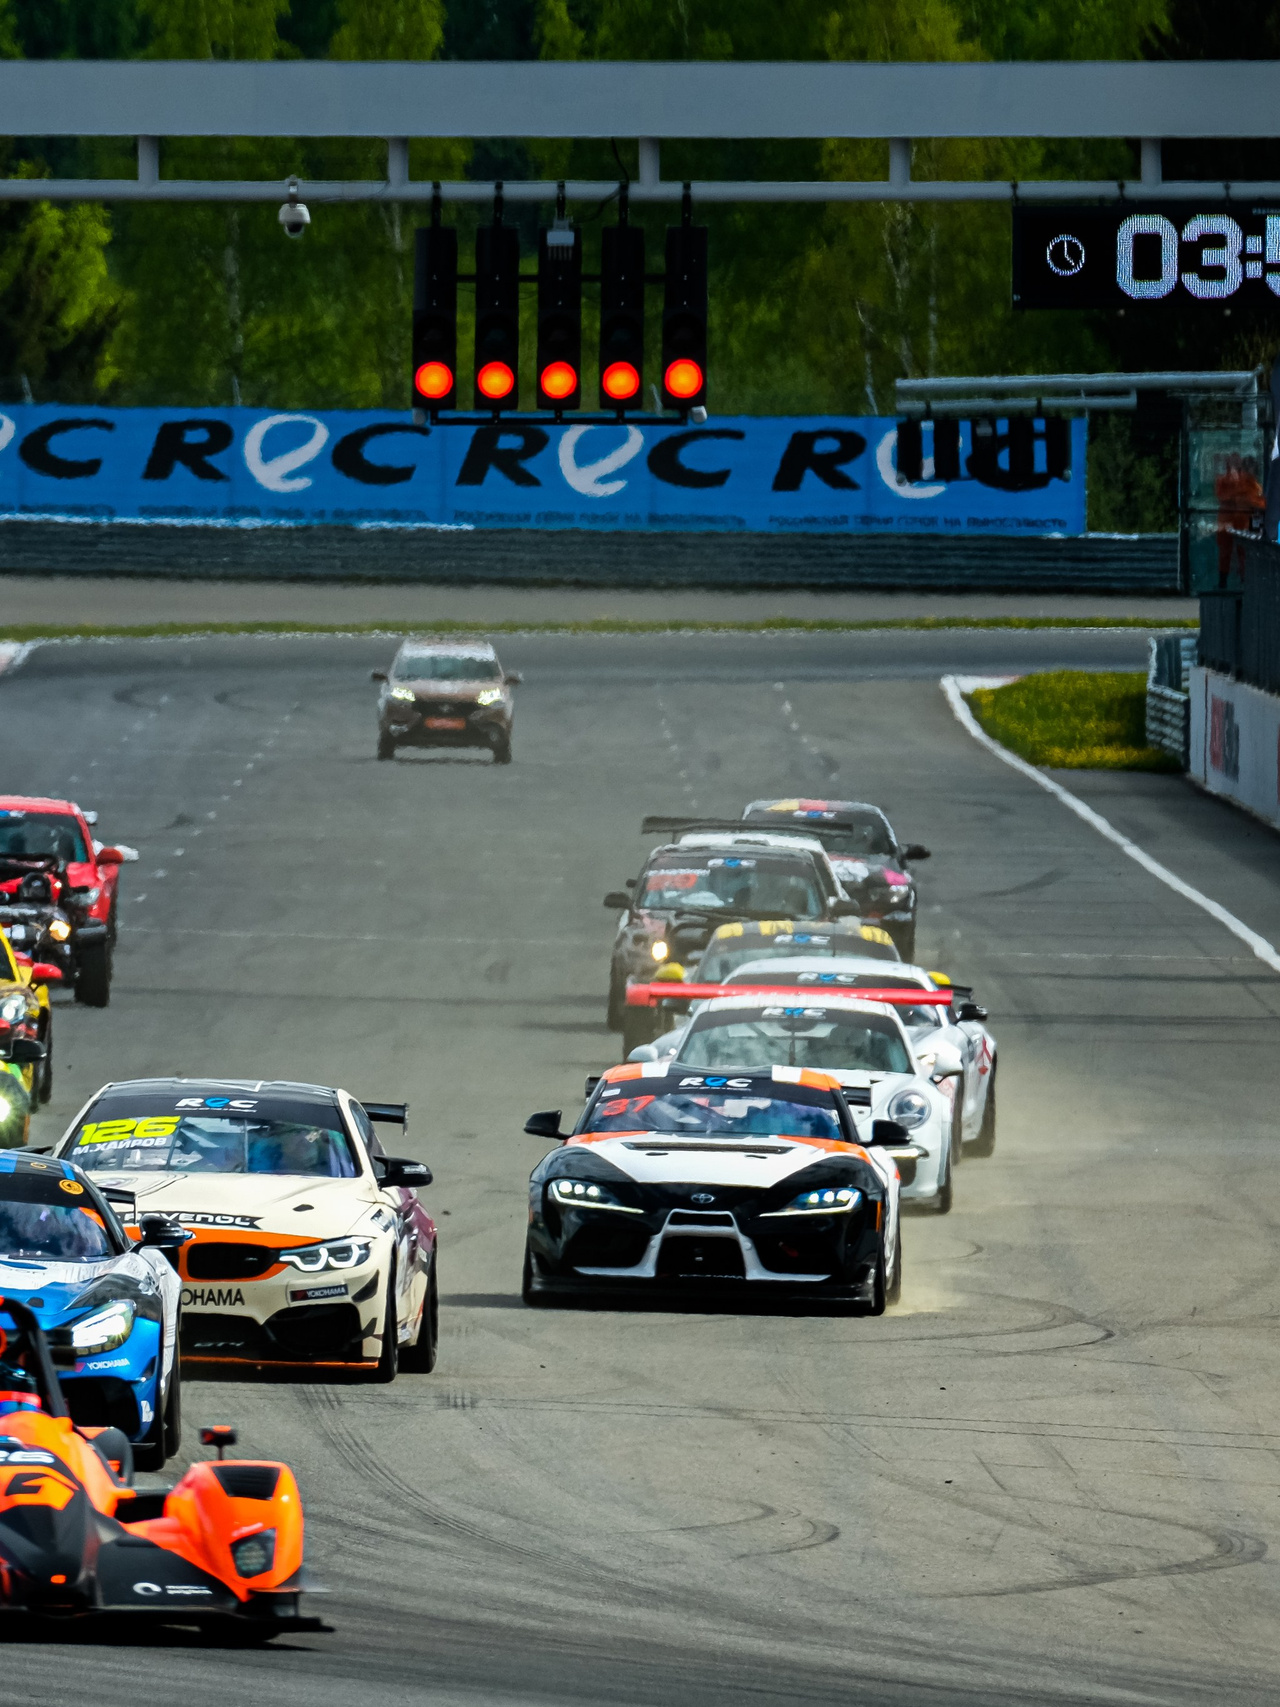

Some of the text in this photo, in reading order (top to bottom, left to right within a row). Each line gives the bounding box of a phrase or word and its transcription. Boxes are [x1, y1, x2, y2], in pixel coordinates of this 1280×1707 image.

[1116, 213, 1280, 300] 03:
[79, 1115, 181, 1146] 126
[124, 1212, 251, 1226] RVENOL
[306, 1286, 346, 1298] YOKOHAMA
[86, 1357, 131, 1371] YOKOHAMA
